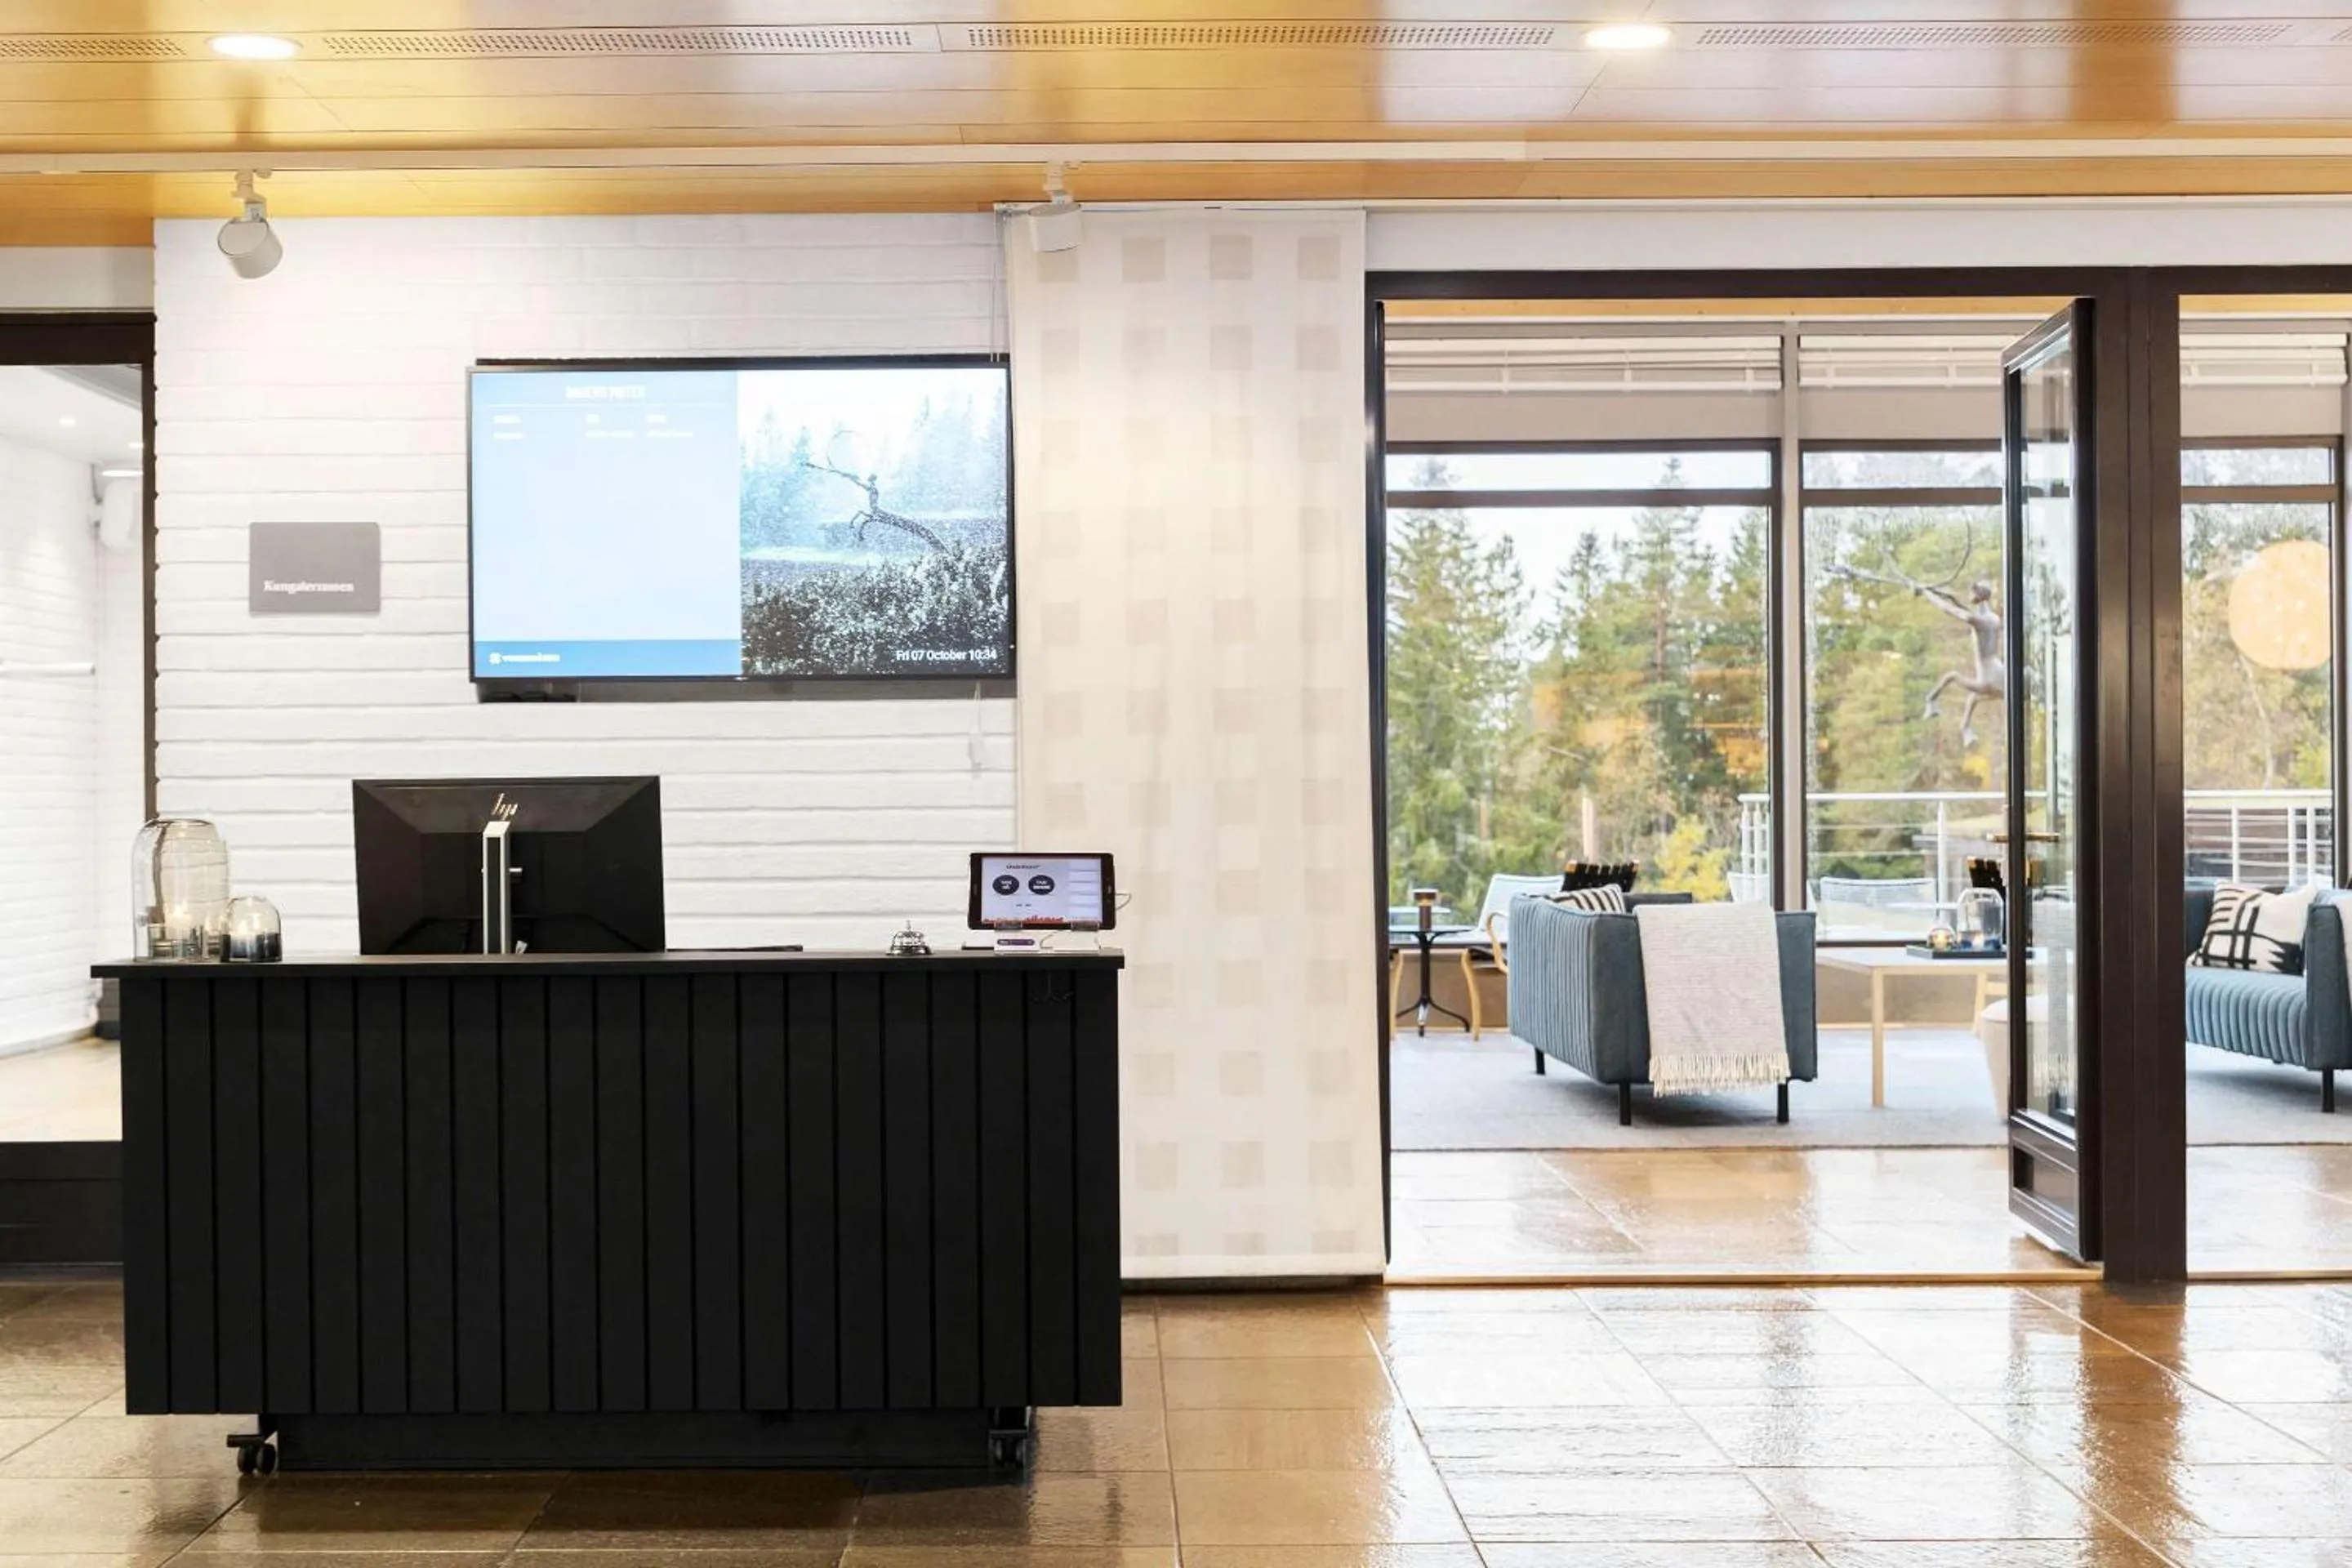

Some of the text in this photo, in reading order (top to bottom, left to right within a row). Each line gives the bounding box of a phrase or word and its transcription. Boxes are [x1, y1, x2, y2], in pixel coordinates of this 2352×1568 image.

[896, 649, 910, 661] Fri
[911, 649, 924, 661] 07
[926, 649, 967, 661] October
[490, 792, 519, 821] hp
